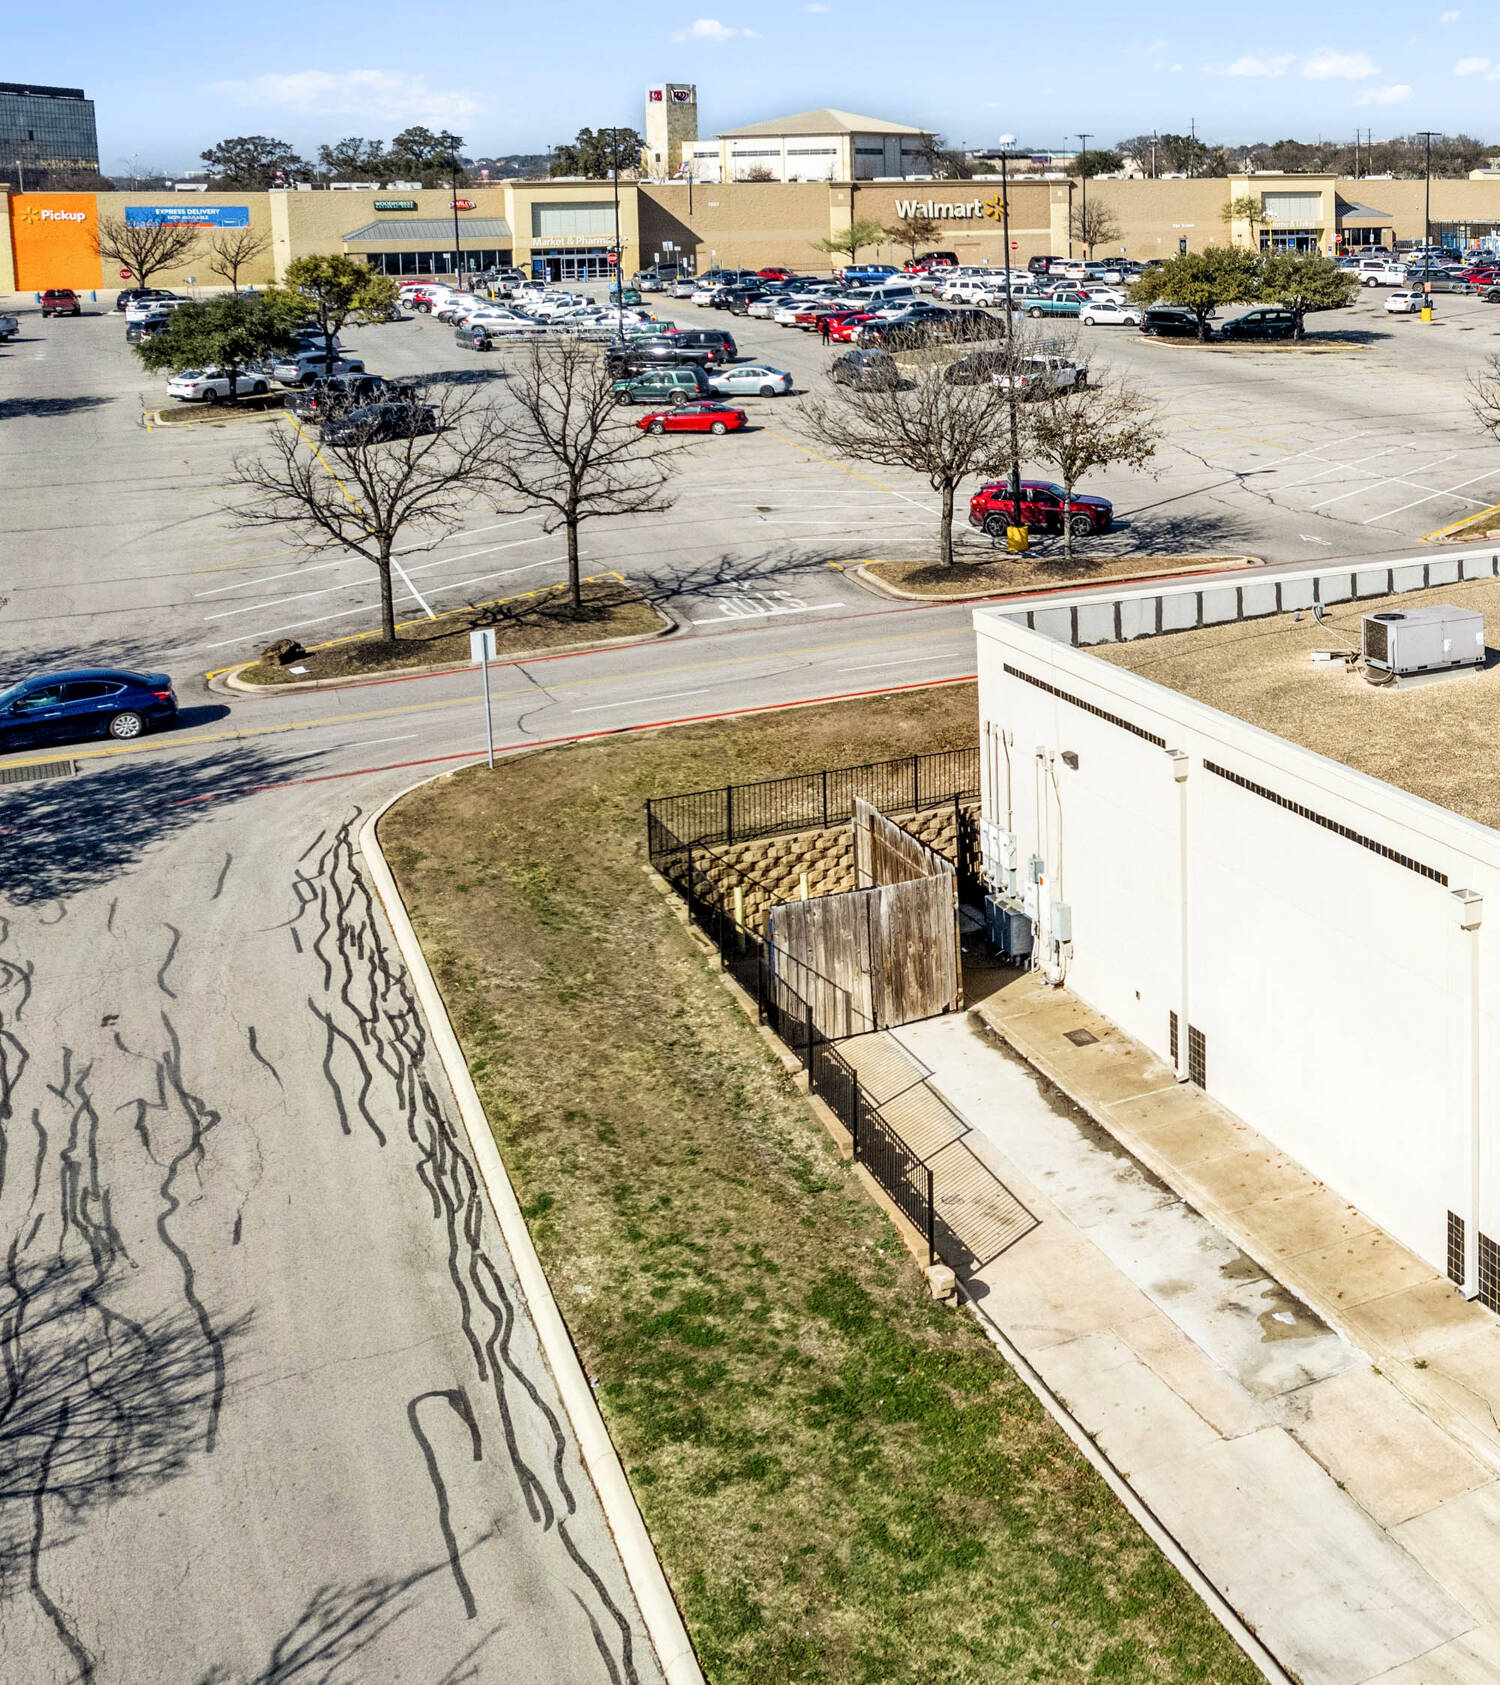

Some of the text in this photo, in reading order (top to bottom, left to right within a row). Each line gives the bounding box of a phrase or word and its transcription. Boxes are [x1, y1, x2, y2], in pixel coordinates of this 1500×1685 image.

[41, 209, 86, 223] Pickup
[895, 199, 983, 218] Walmart
[533, 237, 564, 248] Market
[567, 236, 574, 245] &
[718, 590, 808, 617] STOP
